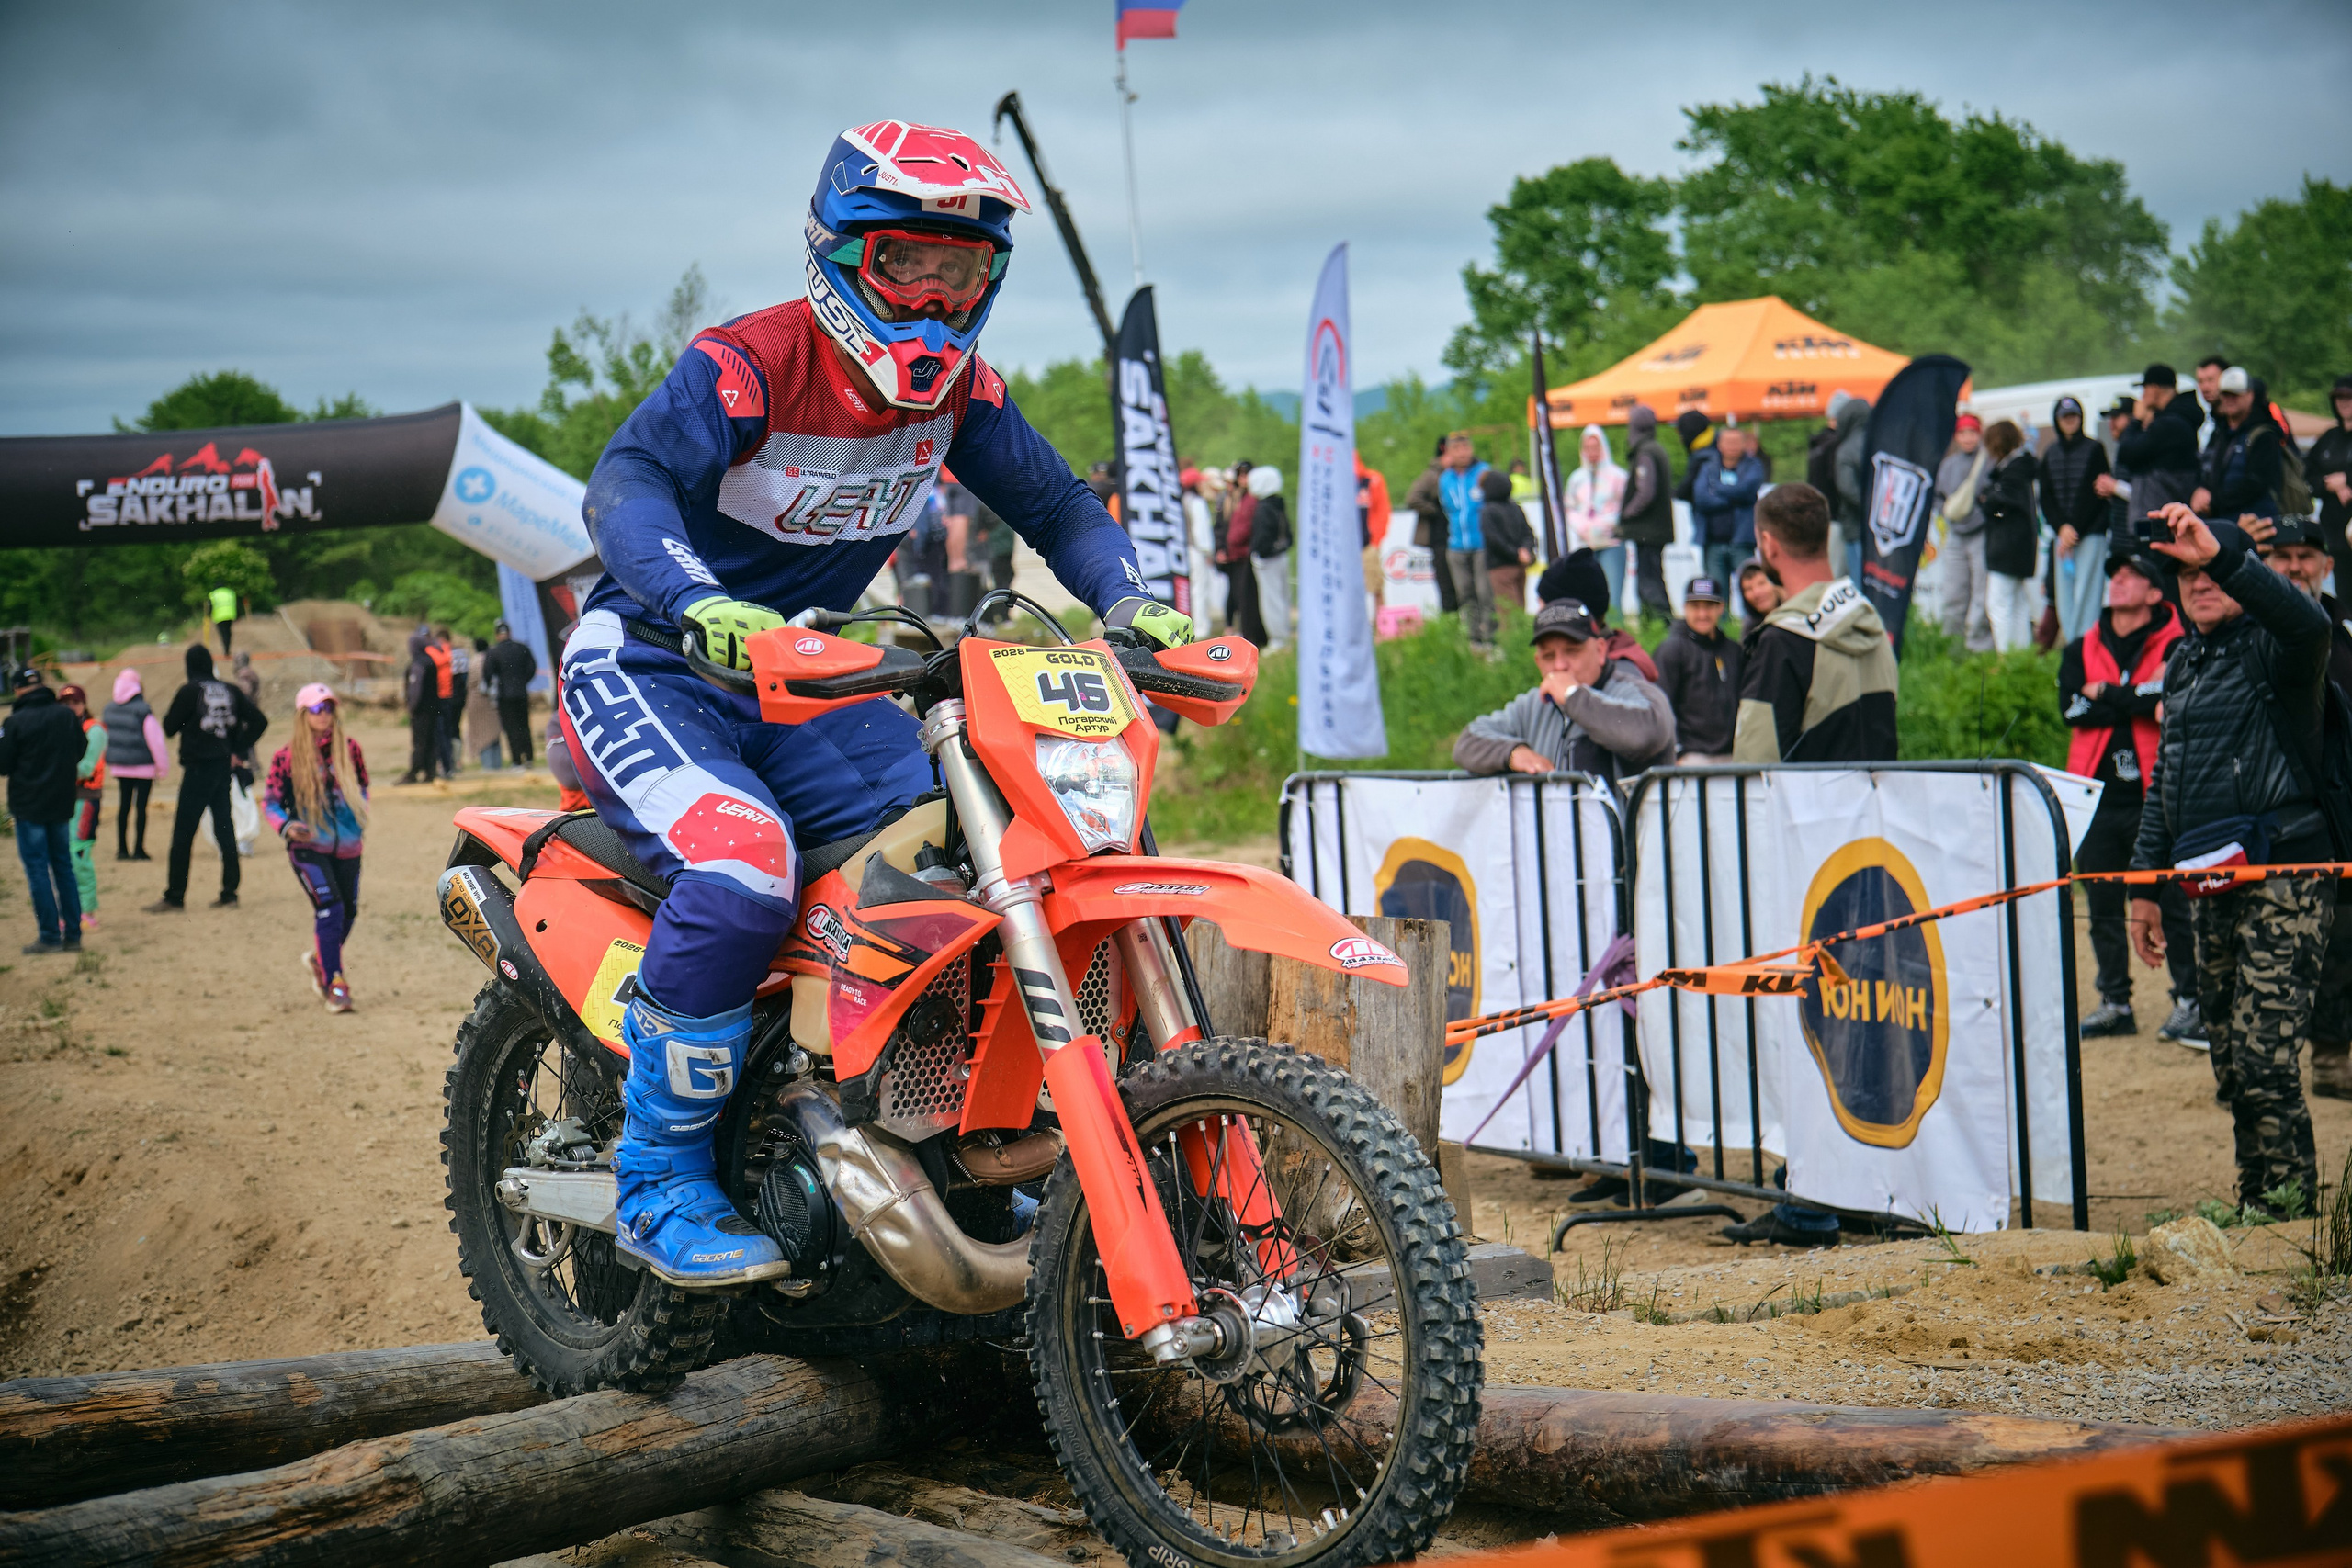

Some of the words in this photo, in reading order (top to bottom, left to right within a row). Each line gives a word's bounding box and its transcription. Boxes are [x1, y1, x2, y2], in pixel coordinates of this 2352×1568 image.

[807, 208, 838, 247] ATT
[106, 474, 230, 498] ENDURO
[1046, 653, 1096, 667] GOLD
[1036, 671, 1110, 713] 46
[1058, 716, 1118, 727] Погарский
[1075, 722, 1110, 733] Артур
[715, 800, 775, 825] LEATT
[614, 940, 642, 953] 2026
[840, 983, 855, 994] READY
[854, 996, 867, 1007] RACE
